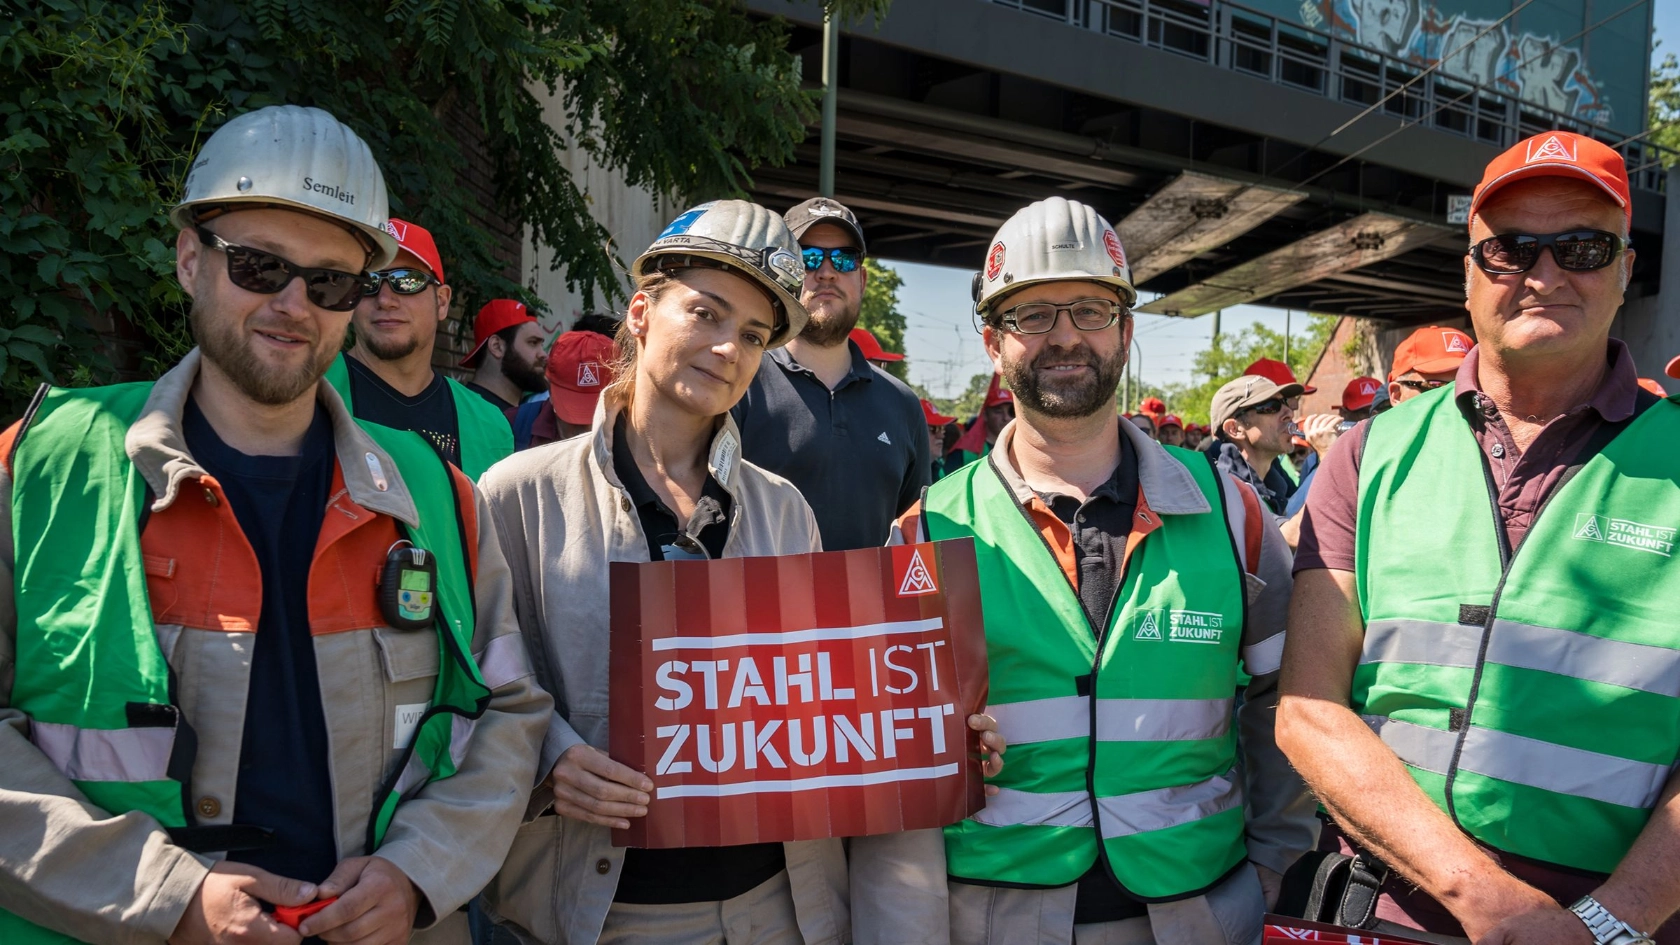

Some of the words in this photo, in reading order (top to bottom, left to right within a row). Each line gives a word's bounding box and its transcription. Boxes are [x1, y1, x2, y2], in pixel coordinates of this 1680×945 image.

[302, 176, 356, 206] Semleit
[1607, 531, 1674, 553] ZUKUNFT
[1610, 522, 1653, 538] STAHL
[1655, 529, 1677, 541] IST
[1169, 614, 1208, 627] STAHL
[1209, 617, 1224, 628] IST
[1169, 626, 1223, 640] ZUKUNFT
[654, 651, 856, 711] STAHL
[869, 640, 945, 697] IST
[656, 703, 955, 776] ZUKUNFT
